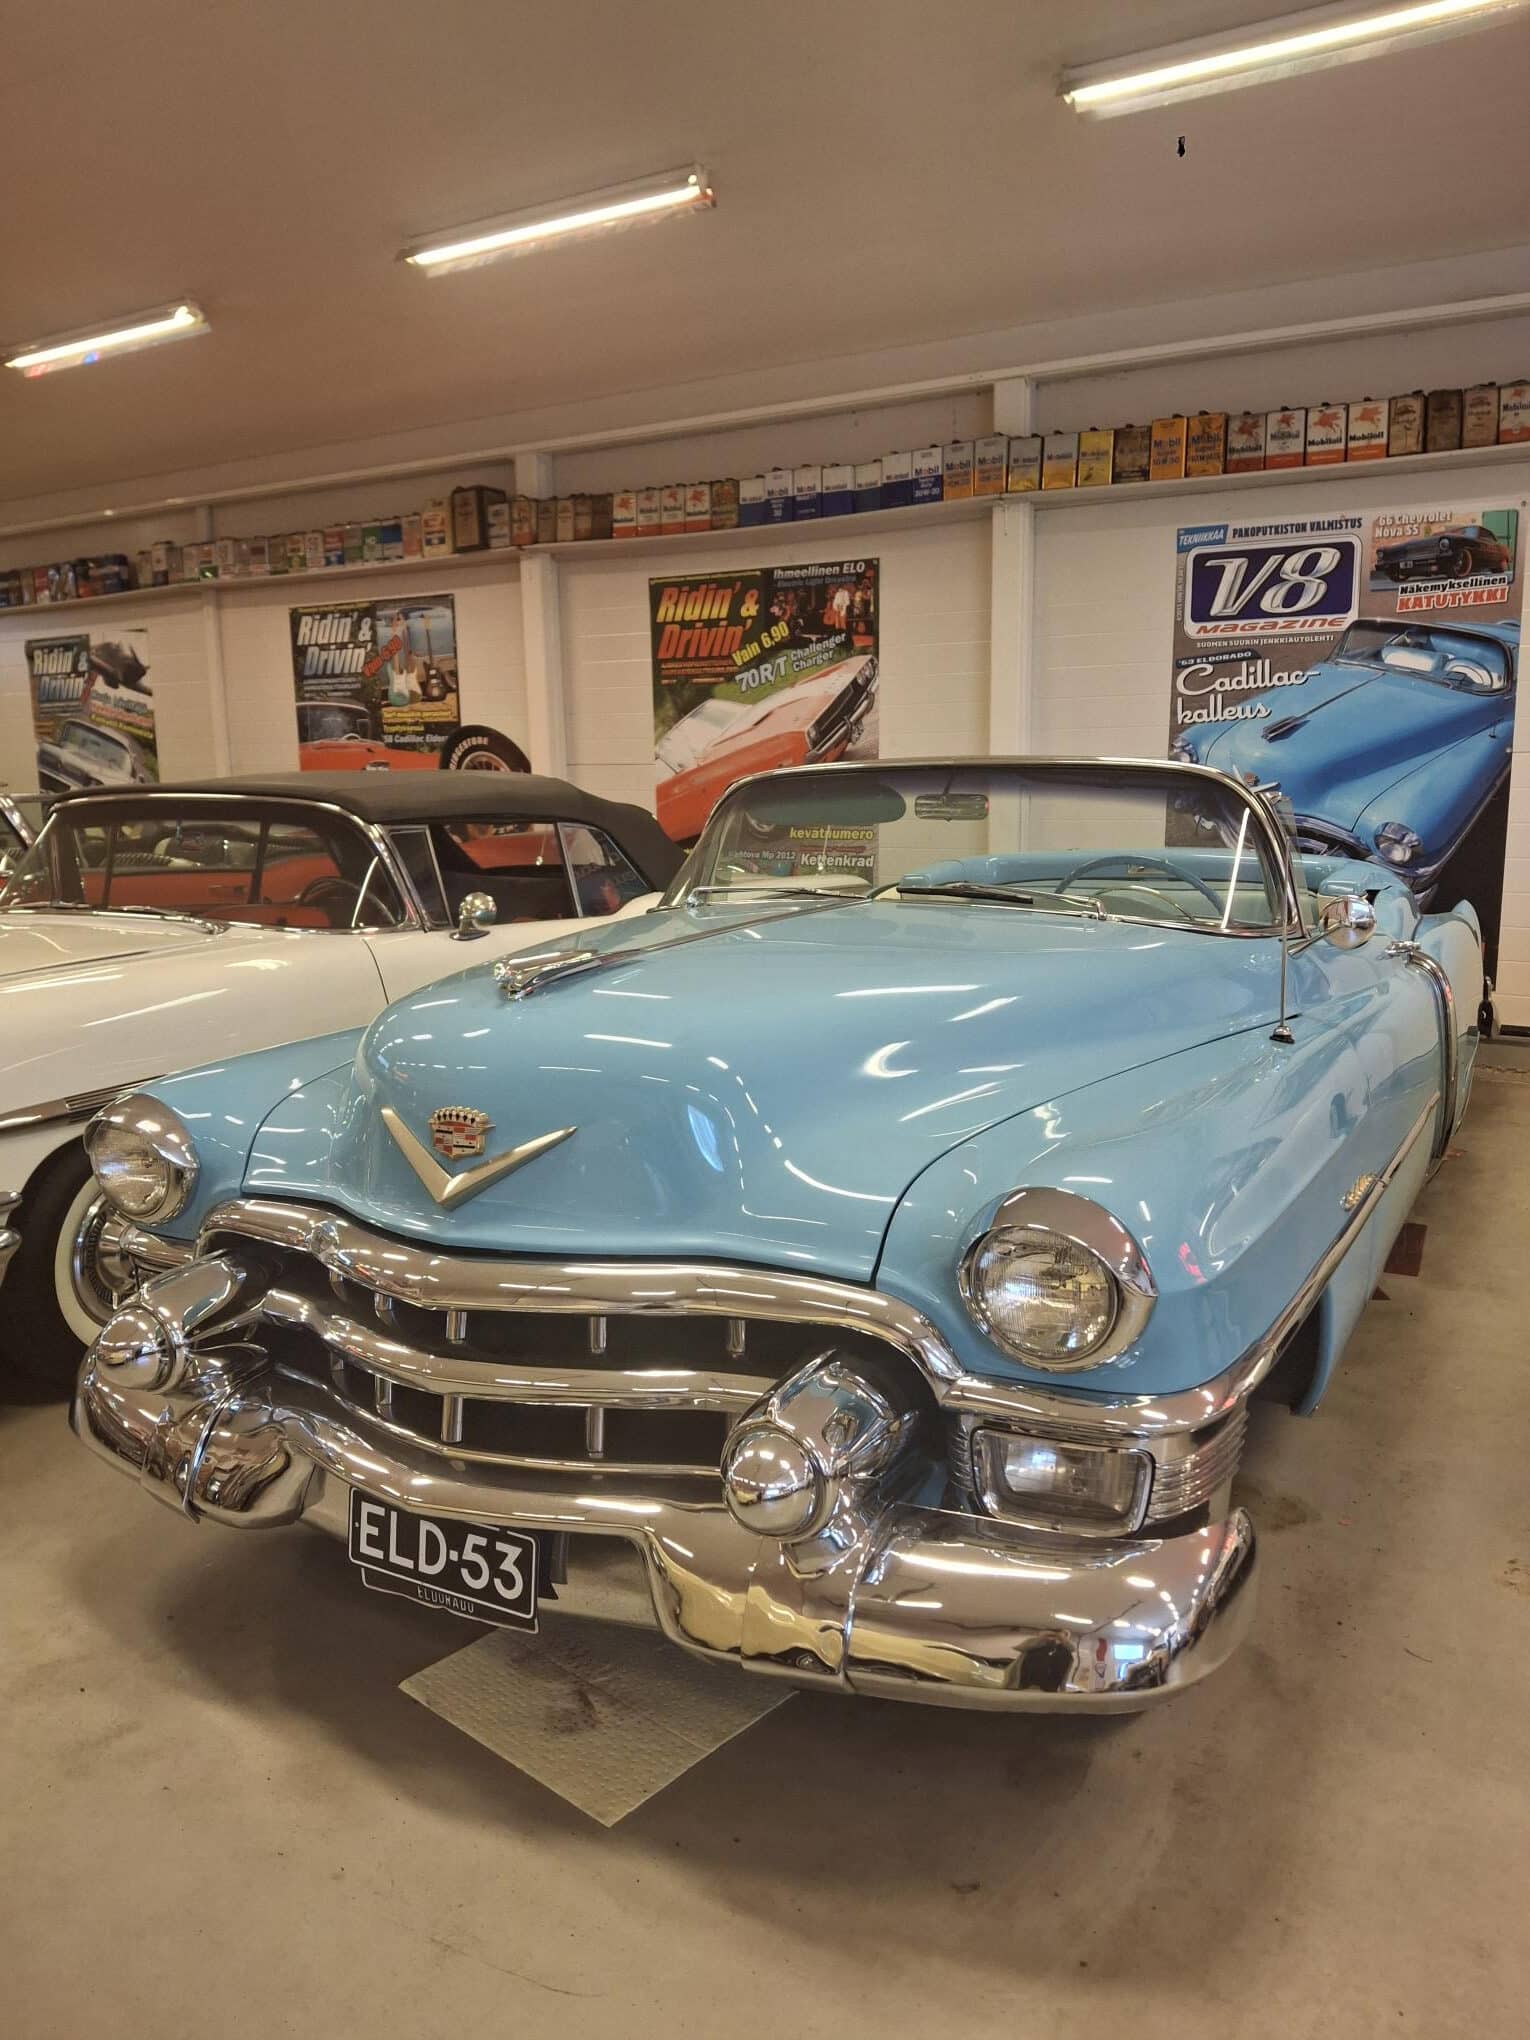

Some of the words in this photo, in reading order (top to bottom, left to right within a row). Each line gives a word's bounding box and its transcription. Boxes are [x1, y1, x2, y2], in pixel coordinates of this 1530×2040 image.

[914, 464, 940, 476] Mobil
[1232, 523, 1307, 539] PAKOPUTKISTON
[1309, 518, 1362, 533] VALMISTUS
[1375, 527, 1403, 539] Nova
[1405, 524, 1420, 536] SS
[773, 563, 840, 580] Ihmeellinen
[842, 560, 866, 574] ELO
[1204, 547, 1342, 617] V8
[1400, 575, 1507, 595] Näkemyksellinen
[656, 581, 742, 623] Ridin'
[740, 588, 760, 617] &
[1398, 588, 1507, 611] KATUTYKKI
[297, 612, 359, 646] Ridin'
[357, 616, 372, 642] &
[656, 618, 753, 659] Drivin'
[732, 641, 761, 666] Vain
[790, 632, 847, 661] Challenger
[1196, 640, 1229, 649] SUOMEN
[1229, 638, 1260, 647] SUURIN
[1260, 634, 1335, 646] JENKKIAUTOLEHTI
[303, 642, 373, 676] Drivin'
[793, 649, 834, 672] Charger
[1196, 651, 1253, 664] ELDORADO
[1176, 658, 1321, 696] Cadillac-
[1177, 693, 1272, 725] kalleus
[800, 853, 875, 868] Kettenkrad
[359, 1500, 525, 1601] ELD-53
